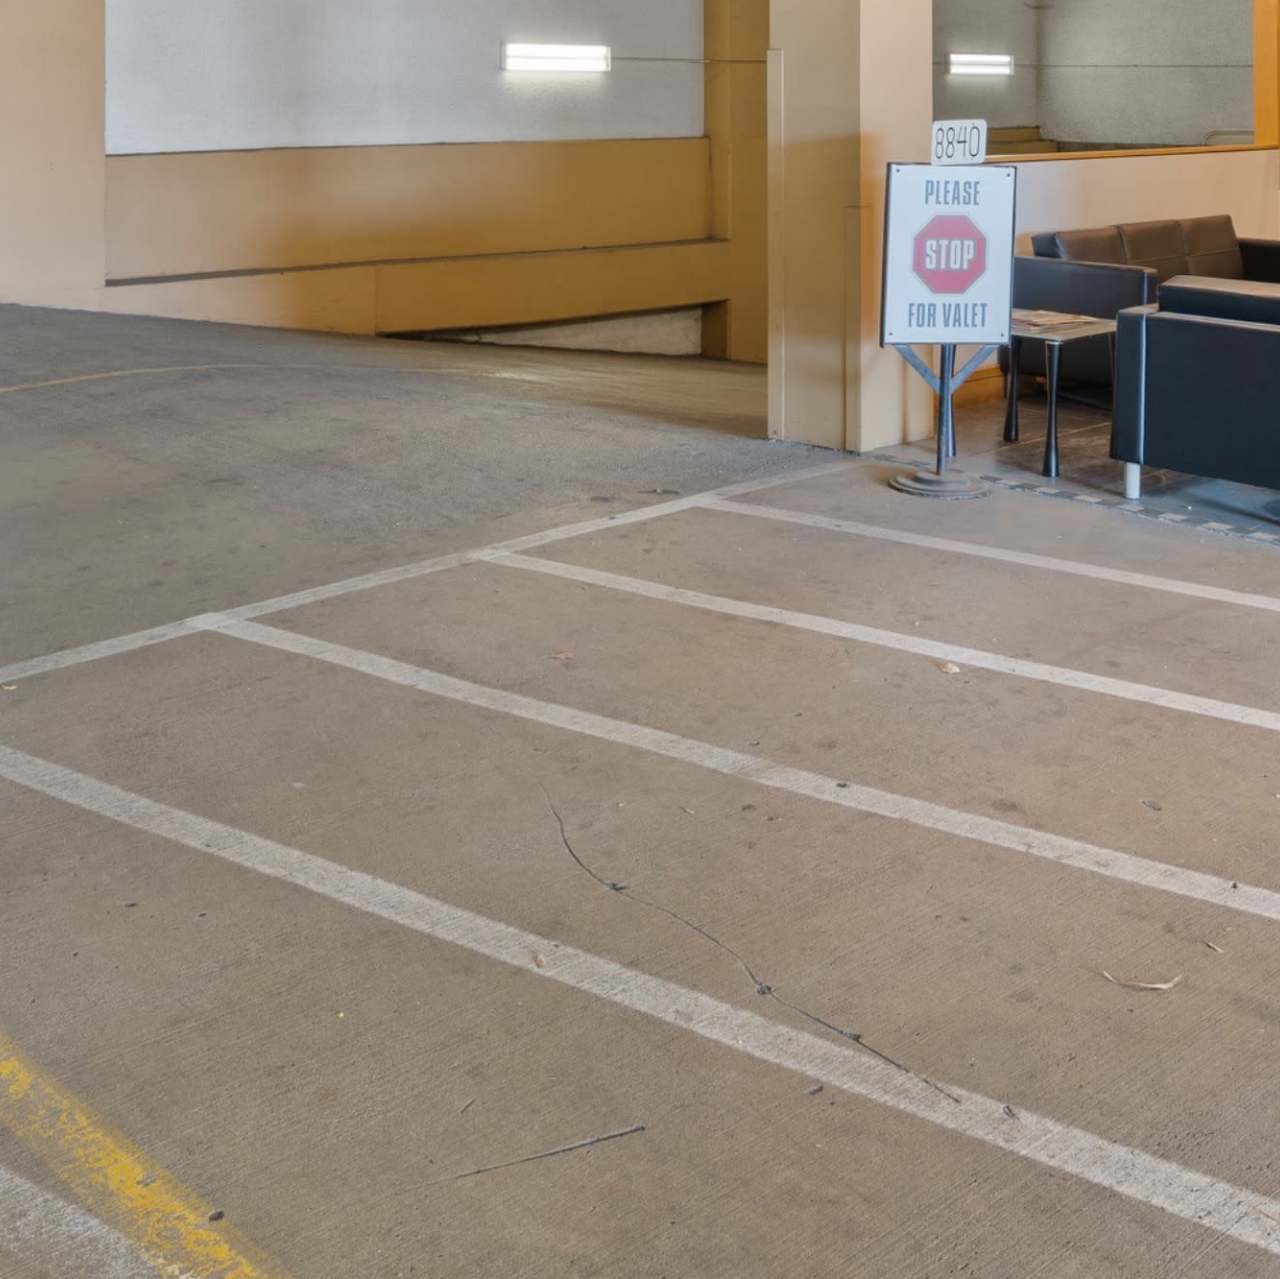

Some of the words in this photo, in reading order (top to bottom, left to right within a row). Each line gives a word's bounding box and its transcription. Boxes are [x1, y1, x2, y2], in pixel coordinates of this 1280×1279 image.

[925, 180, 980, 205] PLEASE
[925, 239, 974, 269] STOP
[908, 303, 937, 328] FOR
[942, 303, 988, 328] VALET
